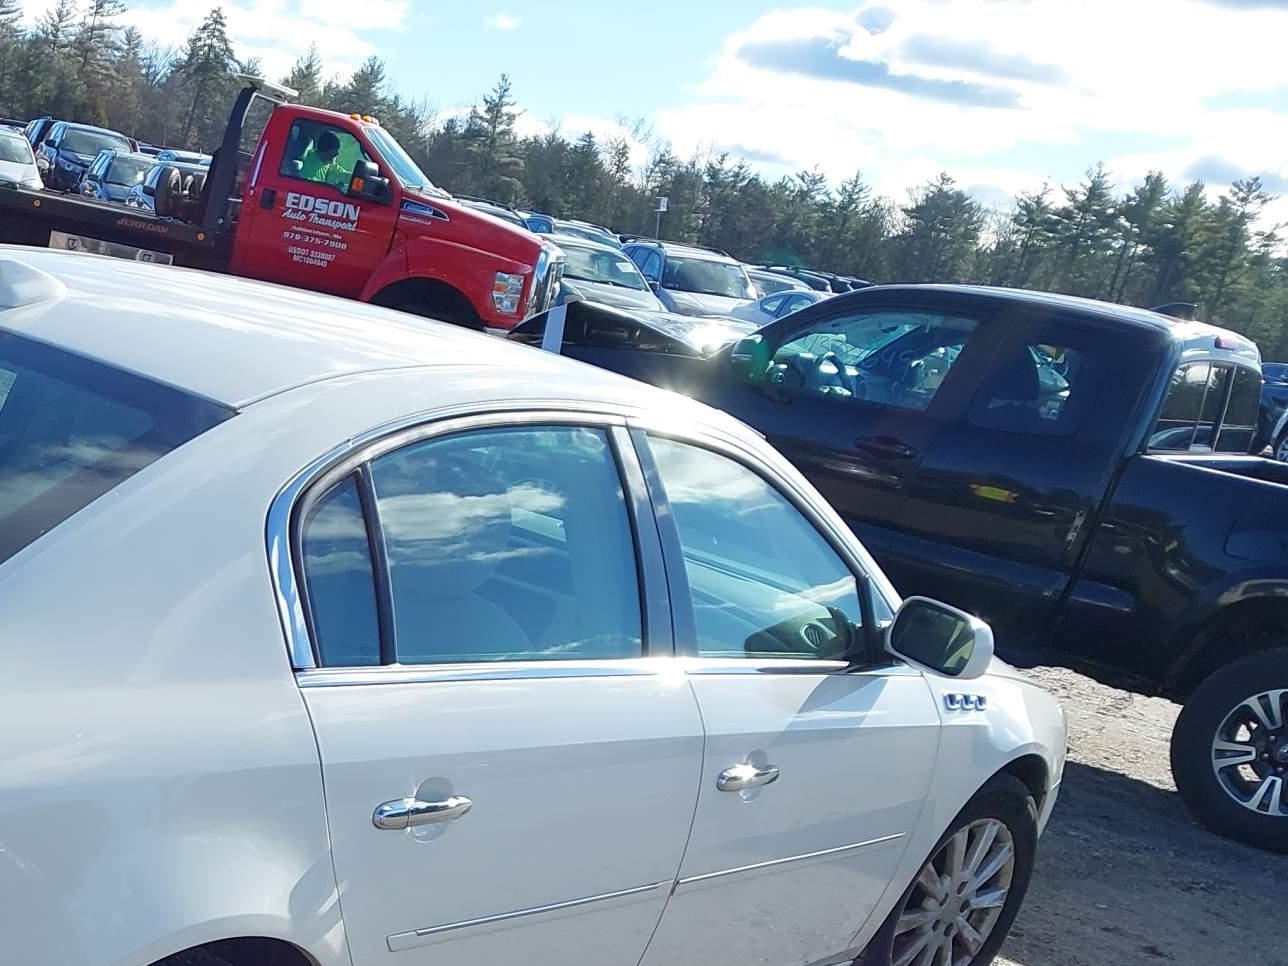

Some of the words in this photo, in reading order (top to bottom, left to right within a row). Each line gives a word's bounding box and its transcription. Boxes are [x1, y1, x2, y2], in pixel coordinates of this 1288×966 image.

[286, 192, 361, 221] EDSON
[282, 208, 307, 221] Auto
[309, 213, 358, 232] Transport
[283, 231, 348, 250] 978-375-7900
